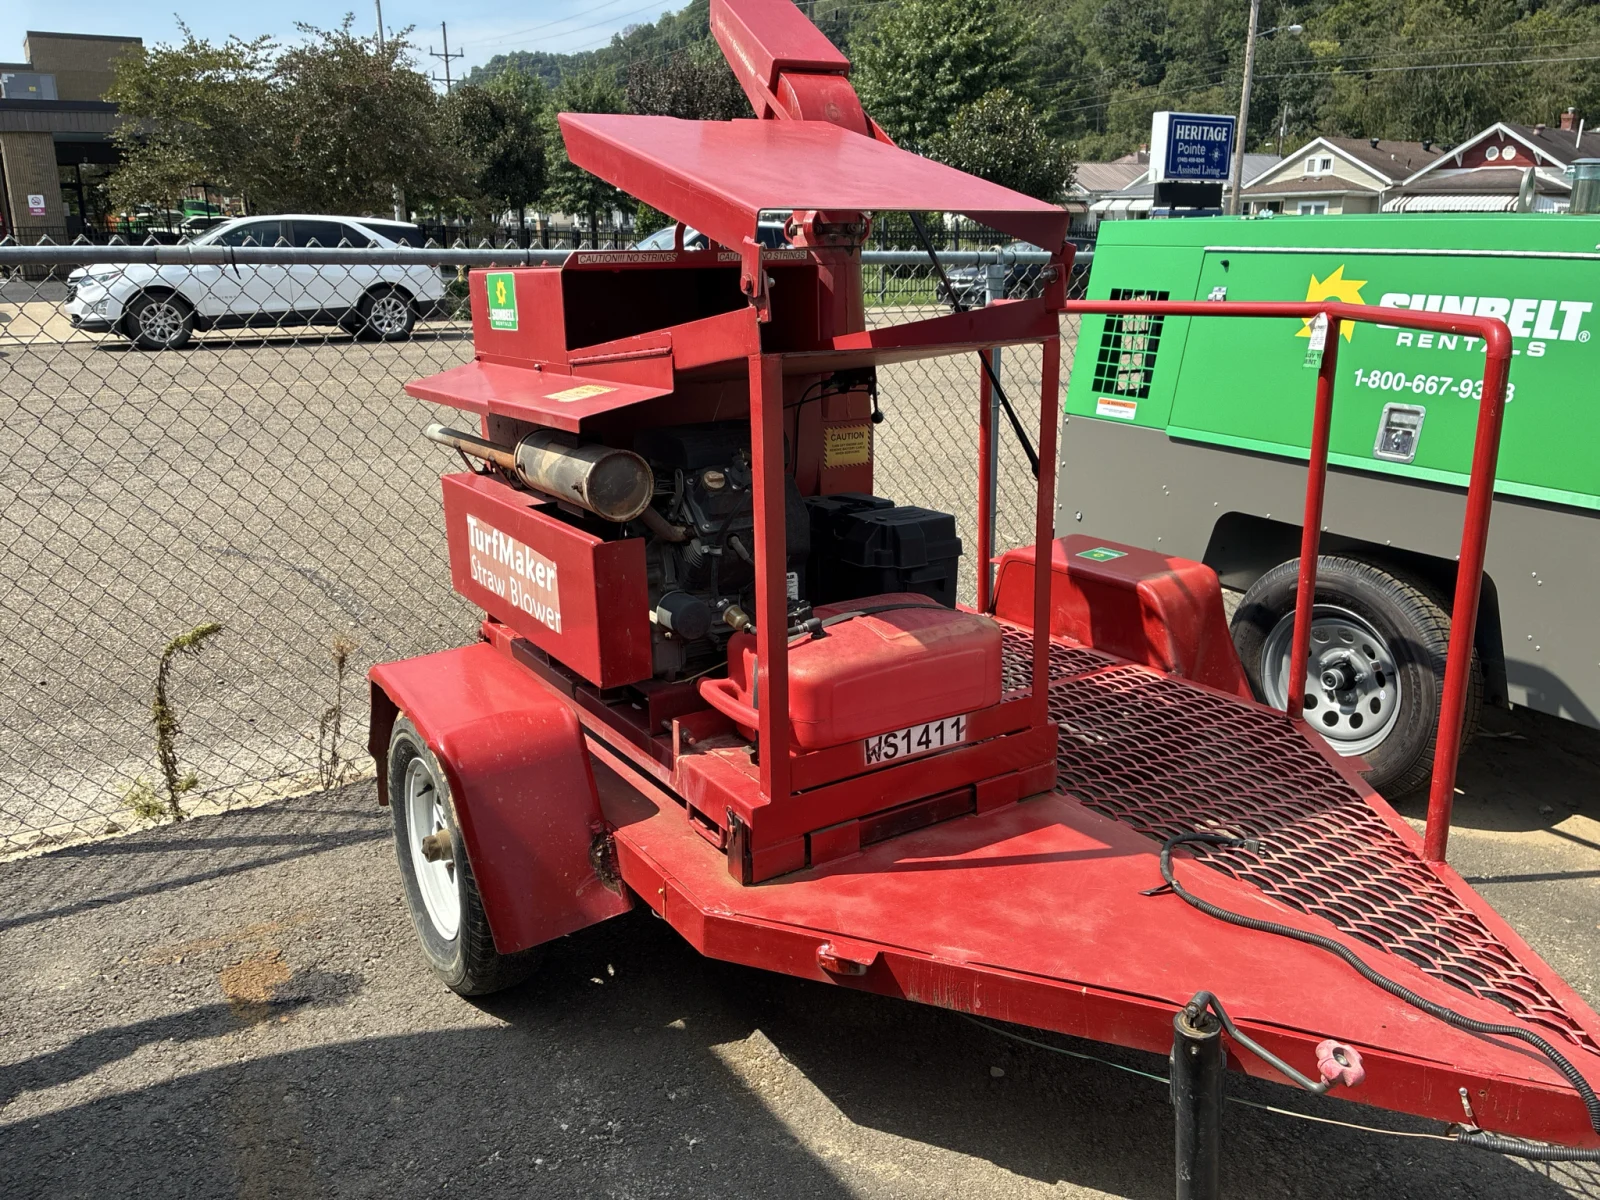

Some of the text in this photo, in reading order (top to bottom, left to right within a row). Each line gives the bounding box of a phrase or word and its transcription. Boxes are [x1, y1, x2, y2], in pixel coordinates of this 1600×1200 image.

[1175, 124, 1228, 141] HERITAGE
[1177, 142, 1206, 155] Pointe
[1177, 164, 1220, 178] Assisted Living
[627, 253, 639, 262] NO
[640, 252, 677, 262] STRINGS
[773, 250, 806, 260] STRINGS
[1396, 332, 1547, 358] RENTS
[1354, 368, 1516, 403] 1-800-667-938
[830, 432, 864, 441] CAUTION
[467, 514, 557, 591] TurfMaker
[471, 554, 562, 633] Straw Blower
[864, 717, 961, 765] WS1411
